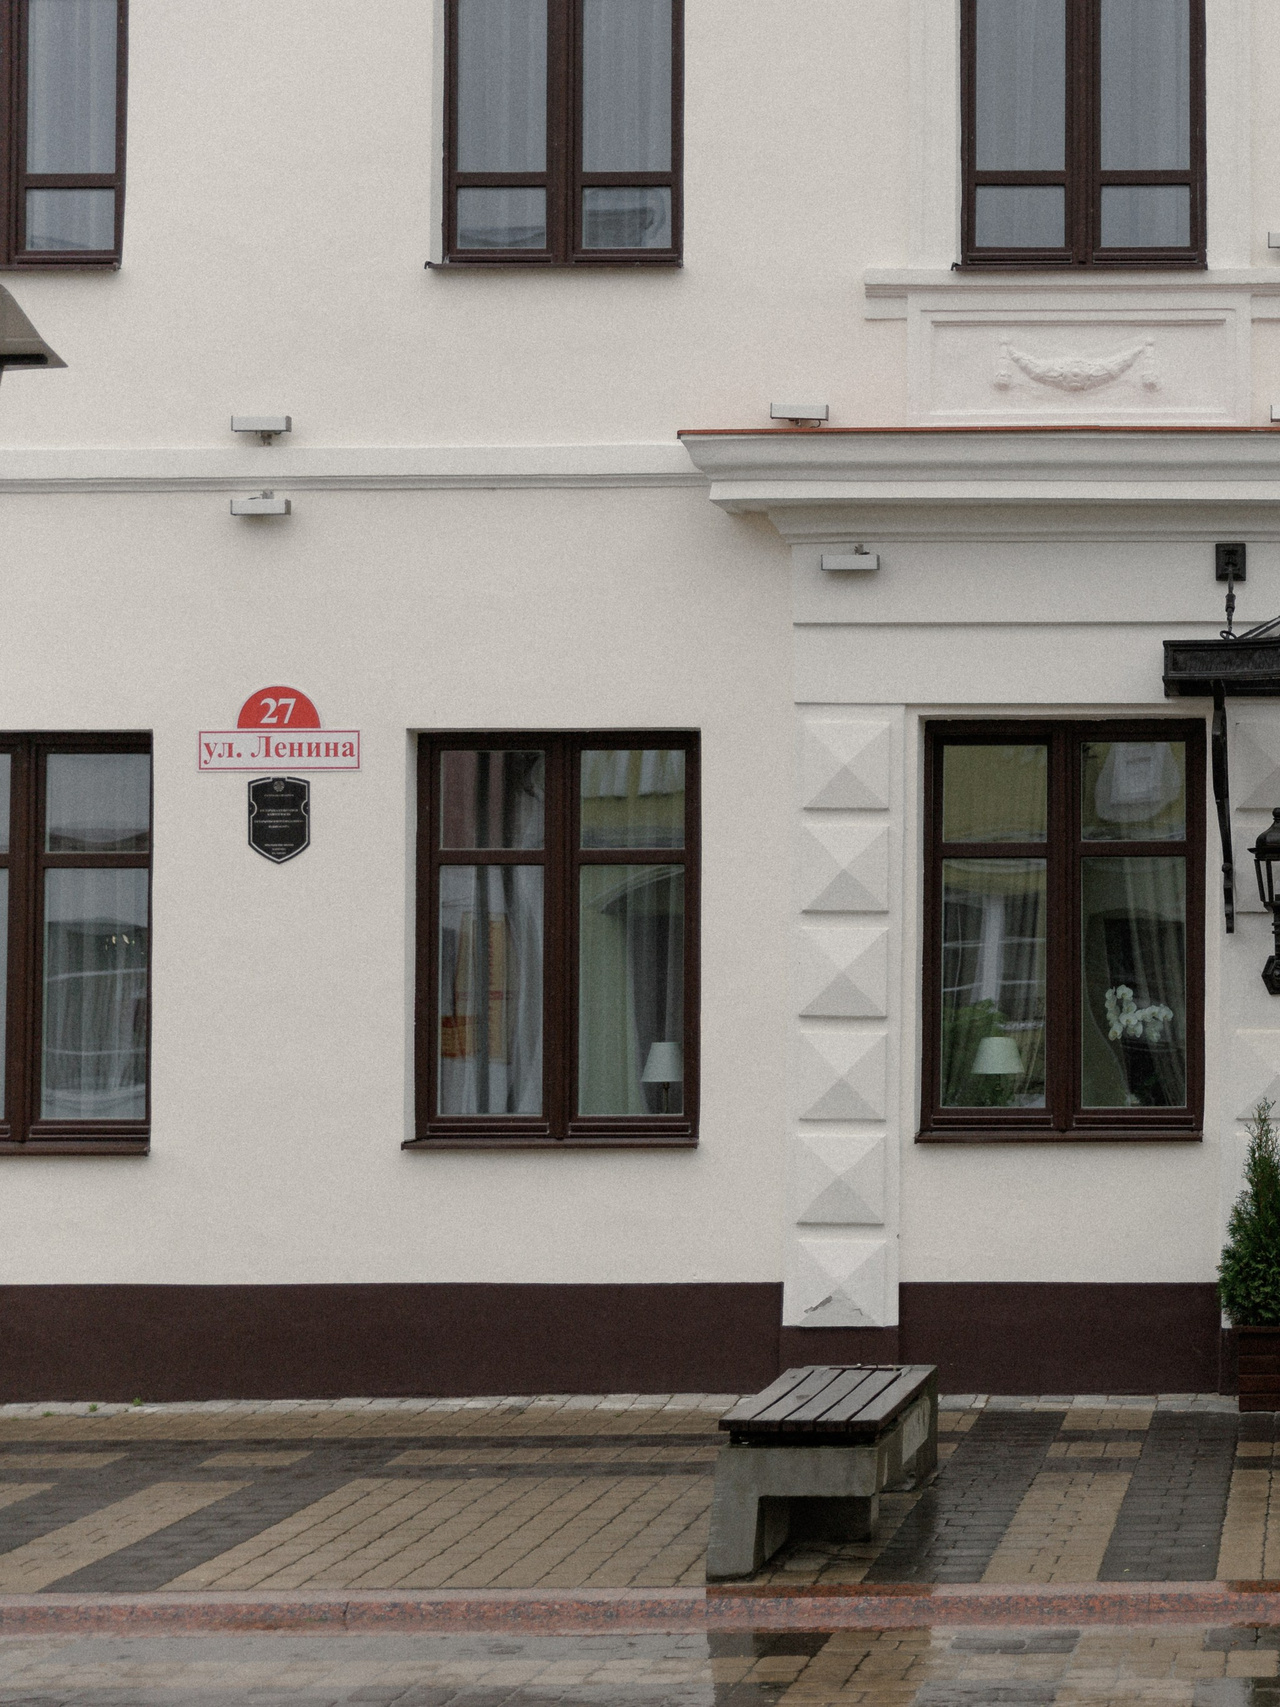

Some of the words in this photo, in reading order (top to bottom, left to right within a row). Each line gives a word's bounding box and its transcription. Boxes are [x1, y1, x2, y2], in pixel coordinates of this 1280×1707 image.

[260, 697, 296, 724] 27
[203, 742, 242, 765] ул.
[251, 735, 355, 758] Ленина
